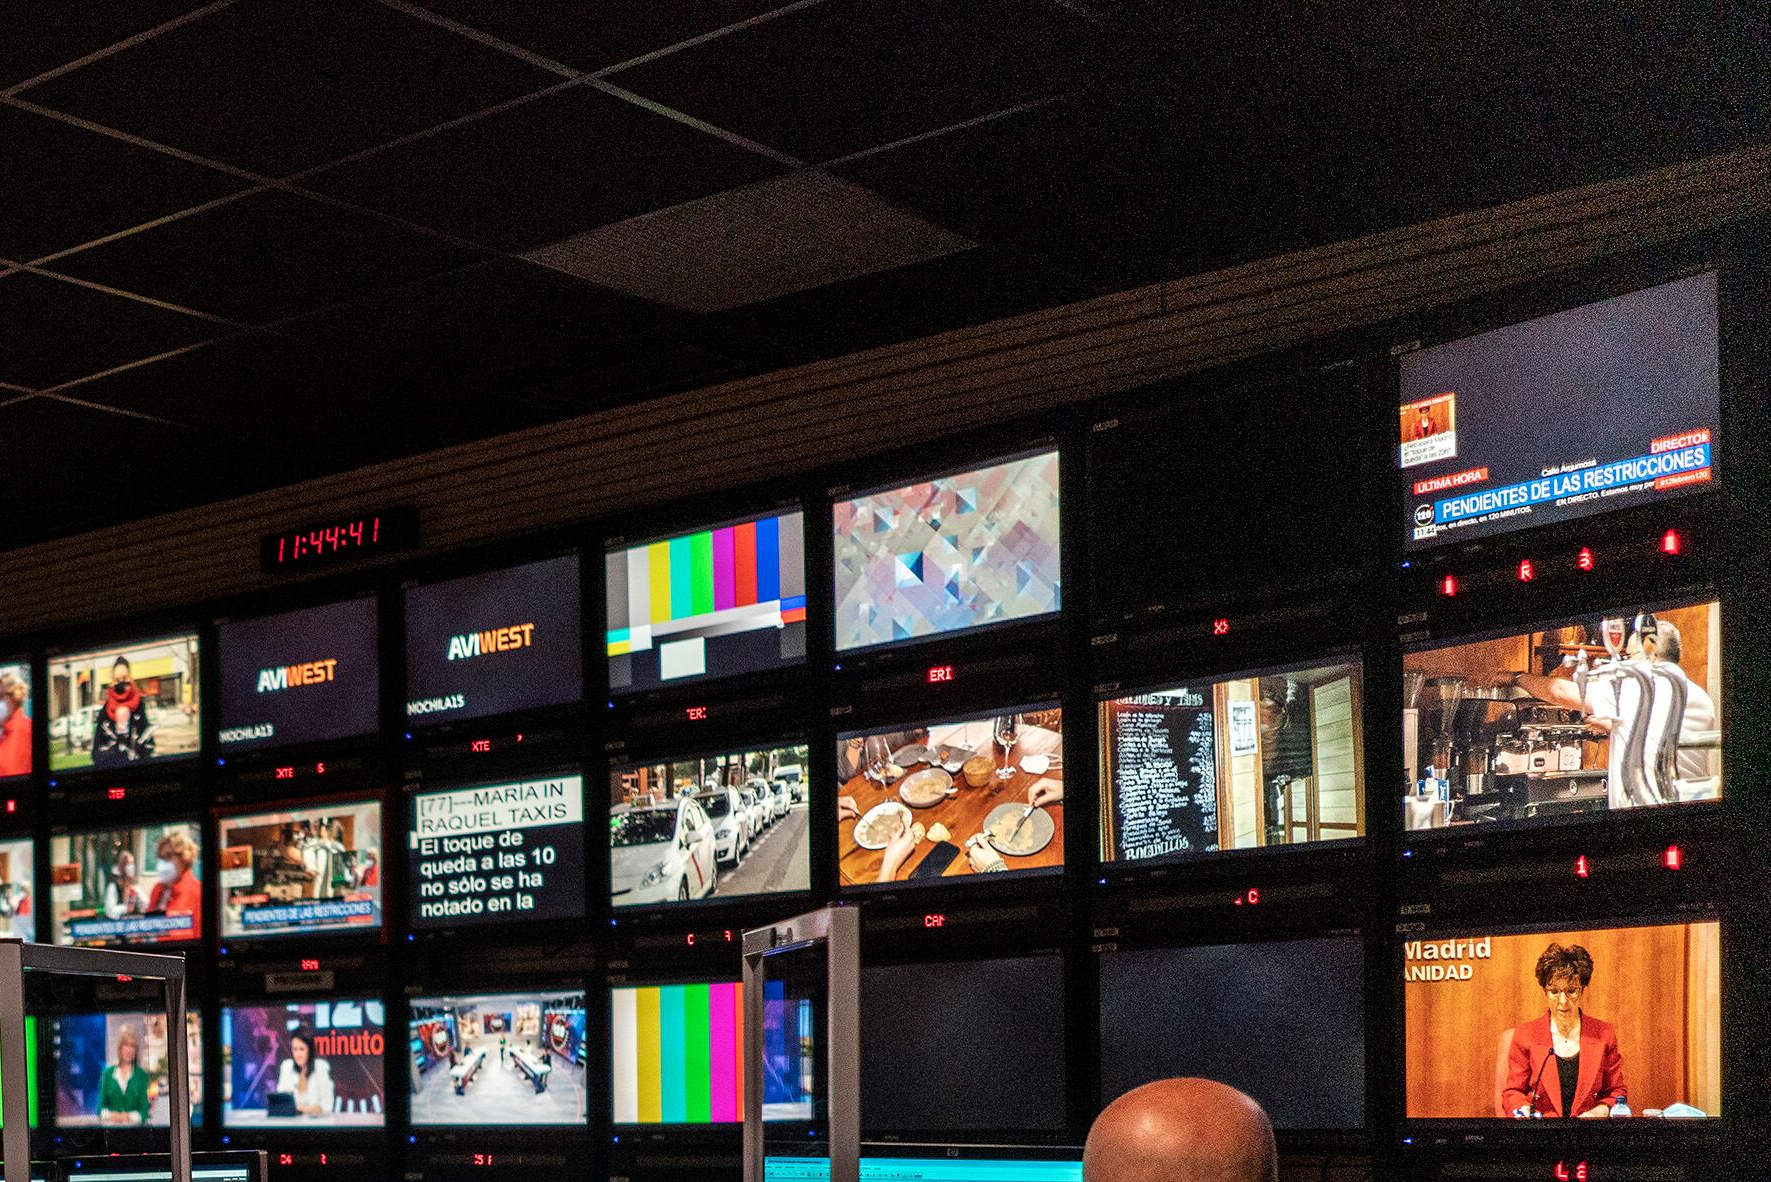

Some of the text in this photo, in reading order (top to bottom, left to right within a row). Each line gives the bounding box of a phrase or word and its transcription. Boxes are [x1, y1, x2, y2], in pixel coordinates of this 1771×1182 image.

[1651, 433, 1702, 453] DIRECTO
[1541, 459, 1596, 477] Calle Argumosa
[1418, 471, 1482, 493] ÚLTIMA HORA
[1442, 447, 1705, 519] PENDIENTES DE LAS RESTRICCIONES
[1601, 487, 1628, 497] Estamos
[1488, 511, 1499, 521] 120
[278, 518, 379, 562] 11:44:41
[447, 623, 535, 660] AVIWEST
[257, 659, 338, 693] AVIWEST
[544, 782, 563, 798] IN
[422, 803, 567, 833] RAQUEL TAXIS
[421, 830, 523, 856] El toque de
[421, 846, 555, 879] queda a las 10
[421, 871, 543, 896] no sólo se ha
[421, 892, 534, 917] notado en la
